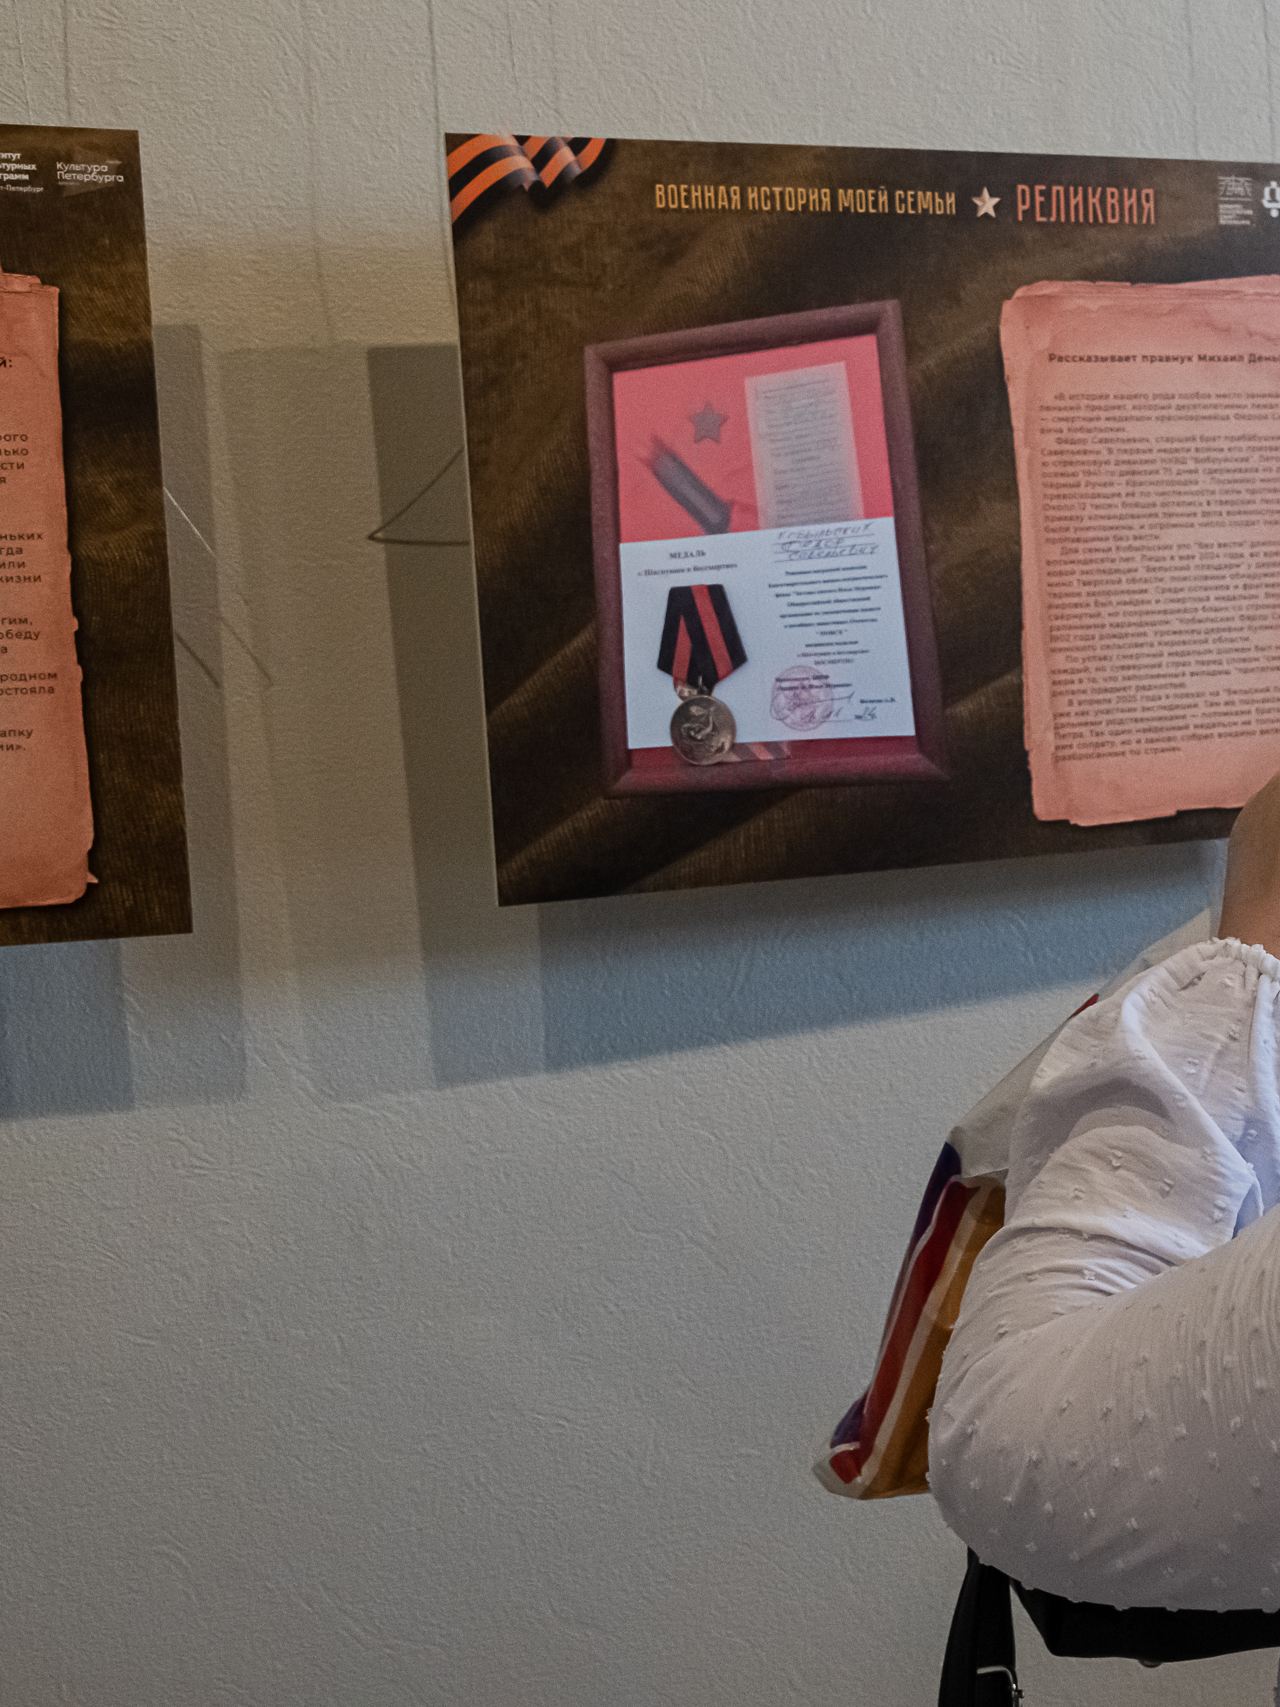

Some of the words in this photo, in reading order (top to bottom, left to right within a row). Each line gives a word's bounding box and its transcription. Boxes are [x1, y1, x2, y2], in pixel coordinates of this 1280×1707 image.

[0, 163, 37, 172] турных
[56, 161, 108, 173] Культура
[57, 171, 125, 183] Петербурга
[655, 184, 741, 210] ВОЕННАЯ
[748, 186, 831, 212] ИСТОРИЯ
[838, 185, 889, 213] МОЕЙ
[895, 189, 956, 215] СЕМЬИ
[1016, 184, 1155, 225] РЕЛИКВИЯ
[1049, 354, 1137, 362] Рассказывает
[0, 434, 28, 442] ого
[0, 448, 28, 456] ько
